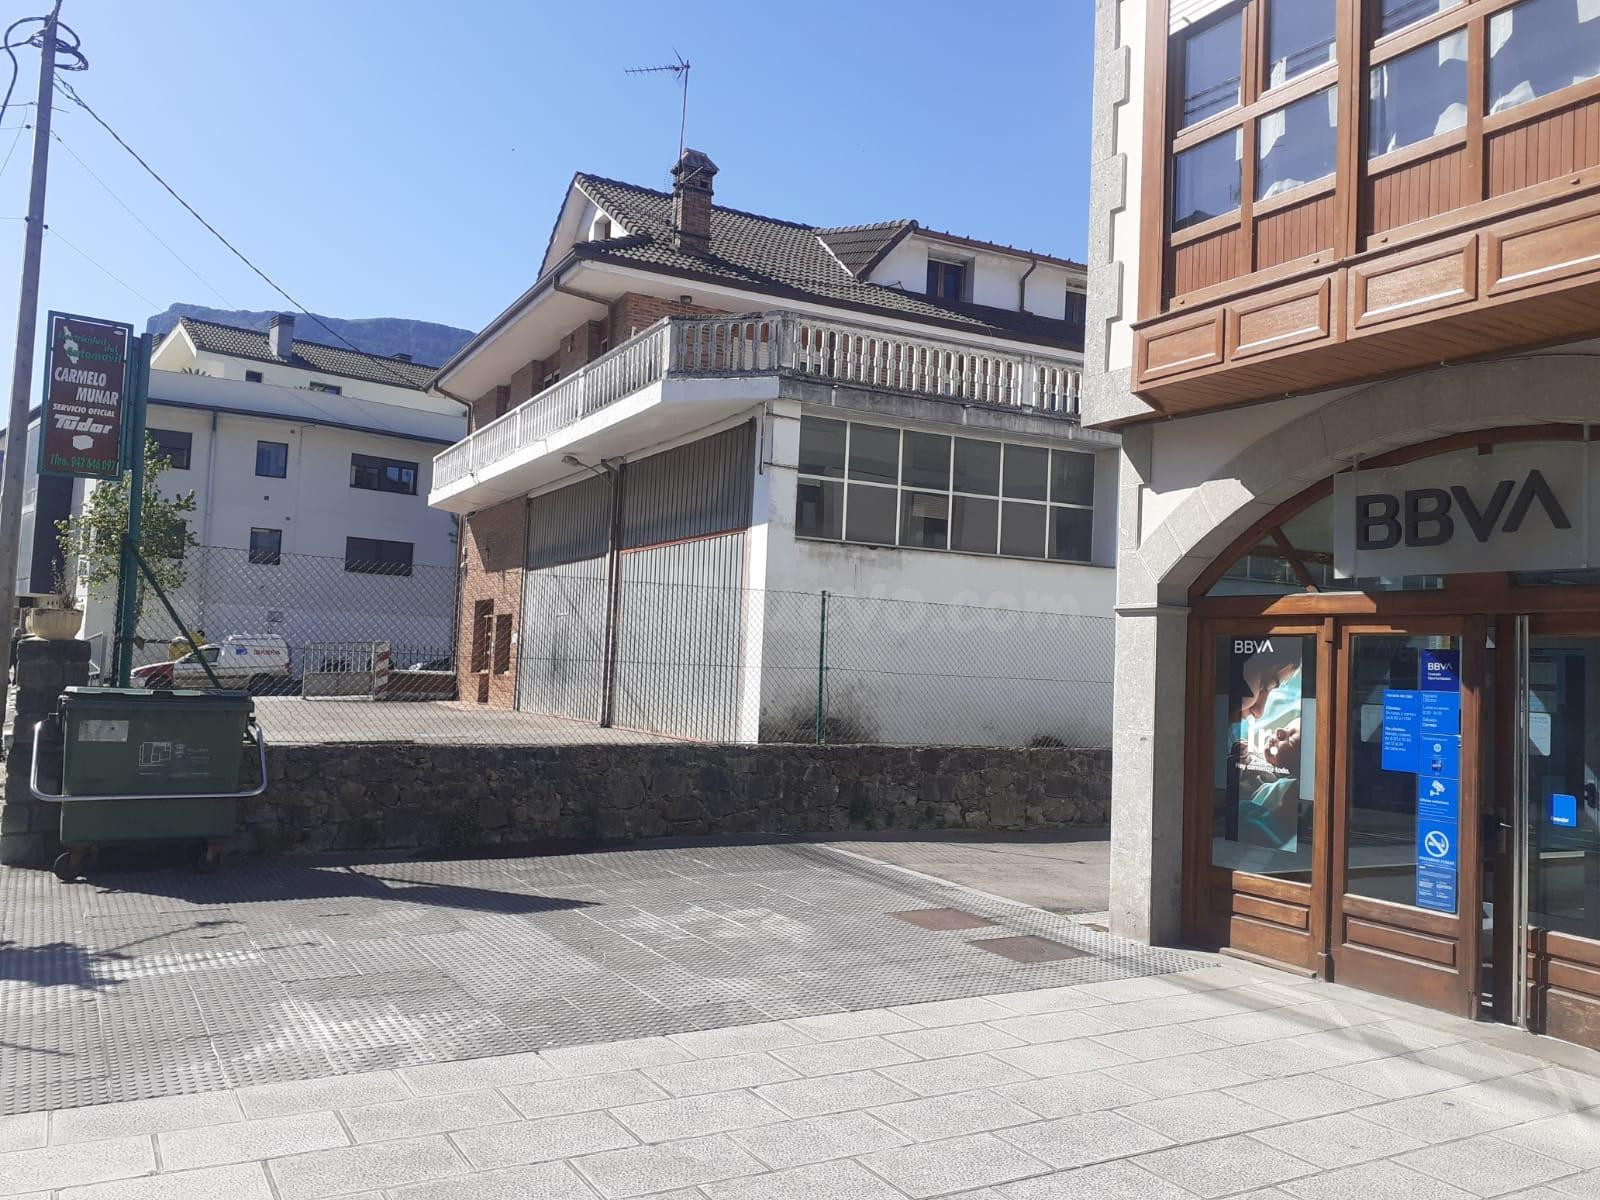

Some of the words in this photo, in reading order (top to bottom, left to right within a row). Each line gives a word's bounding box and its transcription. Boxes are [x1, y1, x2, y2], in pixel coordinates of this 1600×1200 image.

[54, 367, 107, 387] CARMELO
[75, 387, 119, 406] MUNAR
[53, 403, 87, 414] SERVICIO
[88, 407, 116, 417] OFICIAL
[54, 413, 113, 434] Tudor
[1356, 469, 1572, 550] BBVA
[1234, 639, 1274, 654] BBVA
[1427, 662, 1453, 671] BBVA
